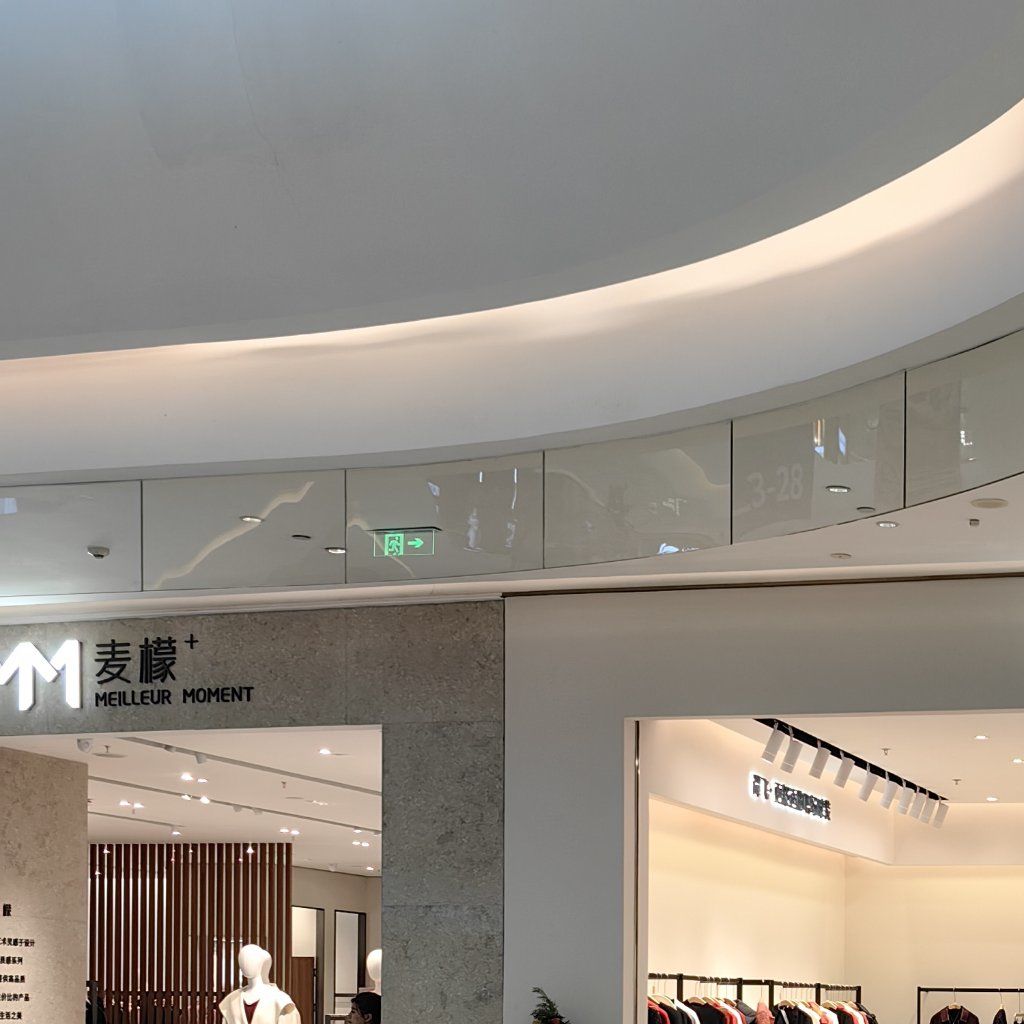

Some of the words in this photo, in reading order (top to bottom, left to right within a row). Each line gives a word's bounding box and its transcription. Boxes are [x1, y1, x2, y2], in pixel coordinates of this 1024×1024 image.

[95, 689, 172, 707] MEILLEUR
[182, 686, 254, 704] MOMENT
[0, 993, 30, 1002] 价比的产品
